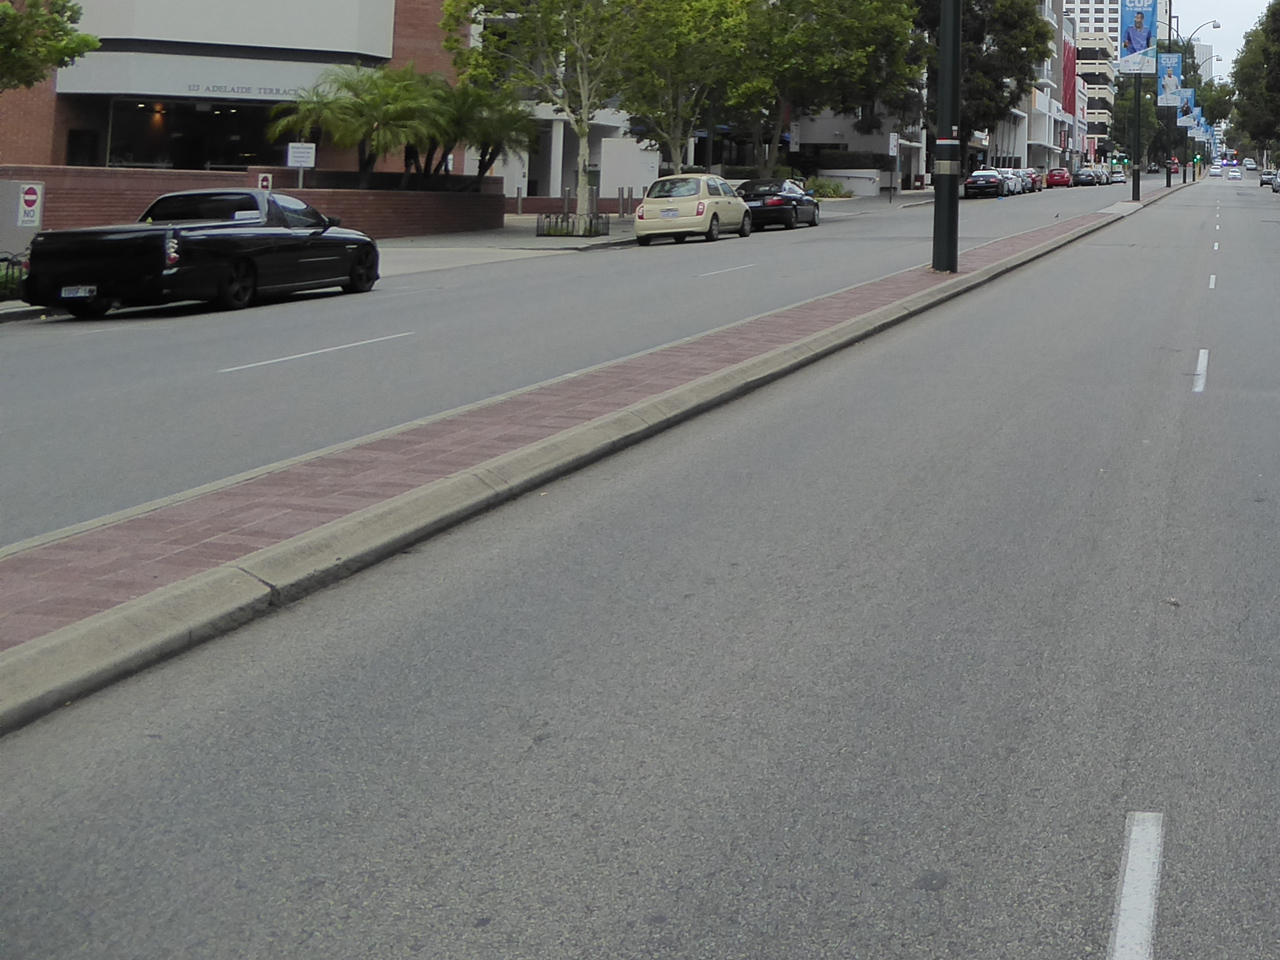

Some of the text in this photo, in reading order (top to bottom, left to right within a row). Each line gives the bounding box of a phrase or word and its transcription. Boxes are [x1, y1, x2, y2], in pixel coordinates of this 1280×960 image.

[204, 85, 253, 94] ADELAIDE
[258, 87, 299, 96] TERRACE
[23, 209, 35, 219] NO
